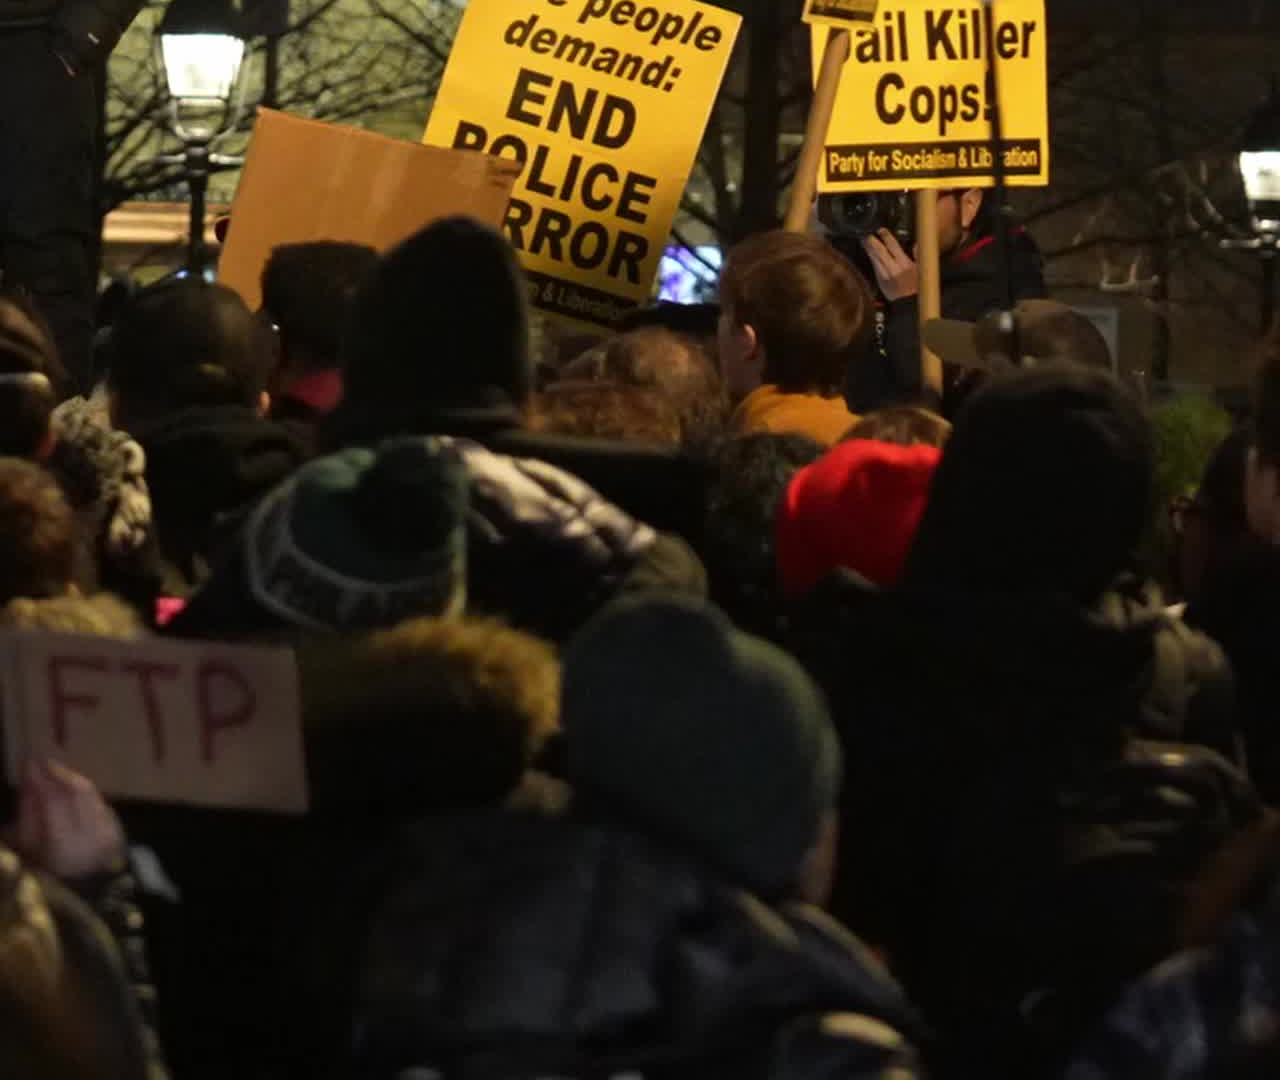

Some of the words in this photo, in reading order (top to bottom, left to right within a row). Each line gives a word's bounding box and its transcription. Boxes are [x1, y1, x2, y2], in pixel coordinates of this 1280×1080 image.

[504, 15, 682, 92] demand:
[506, 68, 637, 150] END
[830, 151, 864, 177] Party
[868, 150, 889, 172] for
[892, 148, 955, 171] Socialism
[971, 145, 1038, 168] Libation
[503, 198, 649, 285] RROR
[48, 656, 258, 767] FTP
